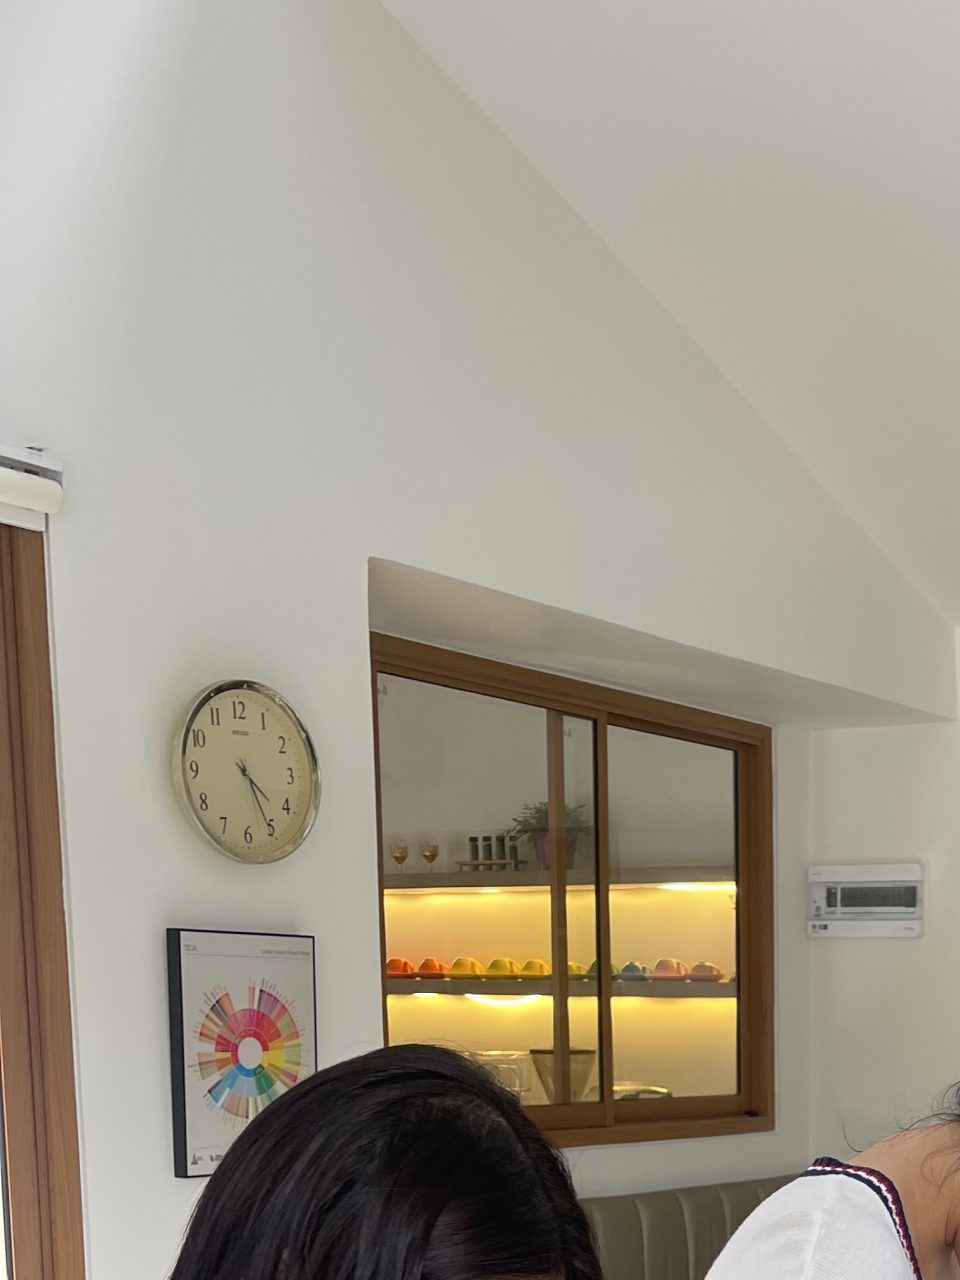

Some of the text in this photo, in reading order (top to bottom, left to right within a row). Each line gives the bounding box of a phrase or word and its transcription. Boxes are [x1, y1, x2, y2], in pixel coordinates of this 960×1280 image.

[210, 707, 220, 726] 11
[232, 701, 246, 720] 12
[261, 712, 266, 731] 1
[192, 729, 205, 748] 10
[278, 736, 287, 754] 2
[190, 761, 199, 779] 9
[287, 768, 295, 785] 3
[200, 793, 208, 811] 8
[282, 798, 290, 815] 4
[219, 817, 227, 835] 7
[244, 825, 253, 844] 6
[267, 819, 275, 836] 5
